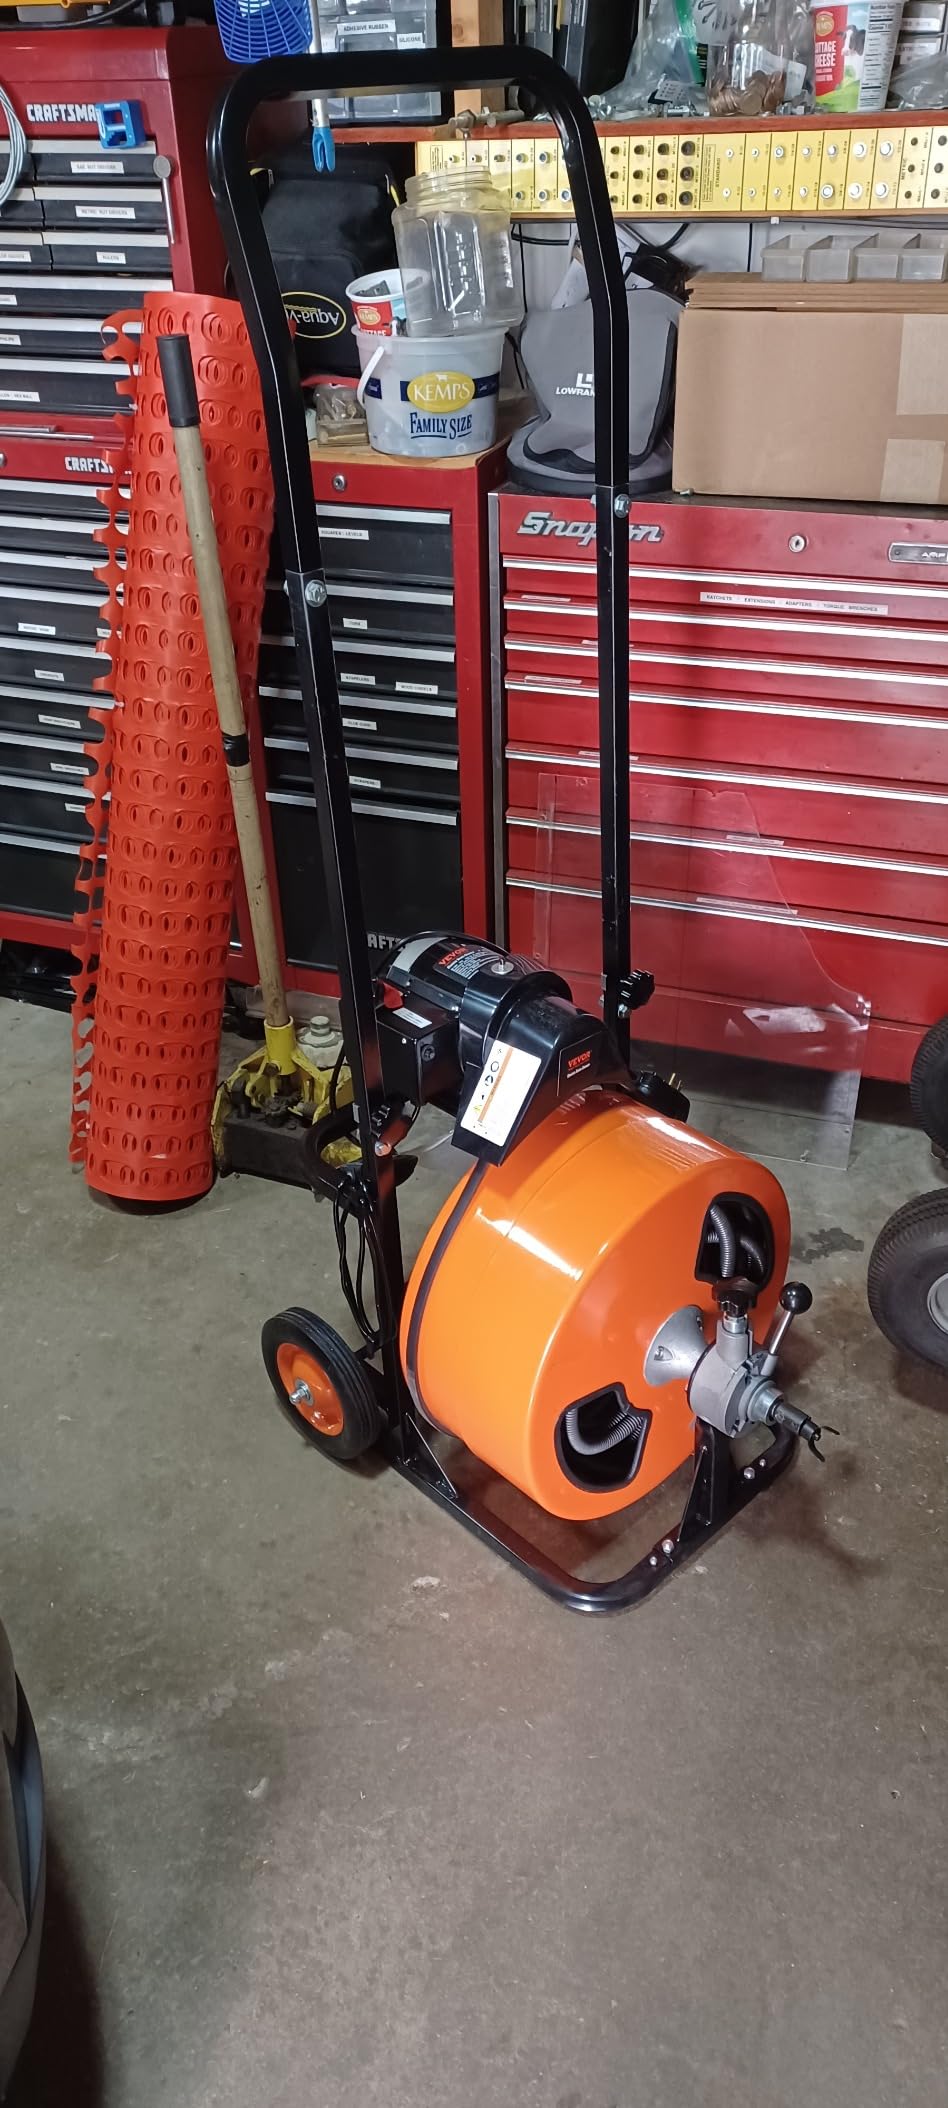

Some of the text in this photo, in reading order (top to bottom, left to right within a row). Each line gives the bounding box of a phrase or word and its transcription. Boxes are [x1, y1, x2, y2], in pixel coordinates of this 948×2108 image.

[368, 23, 389, 31] RUBBER
[26, 103, 99, 122] CRAFTSMA
[289, 308, 340, 326] Aqua-V
[555, 386, 595, 397] LOWRAN
[410, 412, 473, 440] FAMILY SIZE
[516, 511, 664, 546] Snapn
[744, 597, 776, 605] EXTENSIONS
[785, 600, 812, 608] ADAPTERS
[568, 1050, 591, 1068] VEVOR
